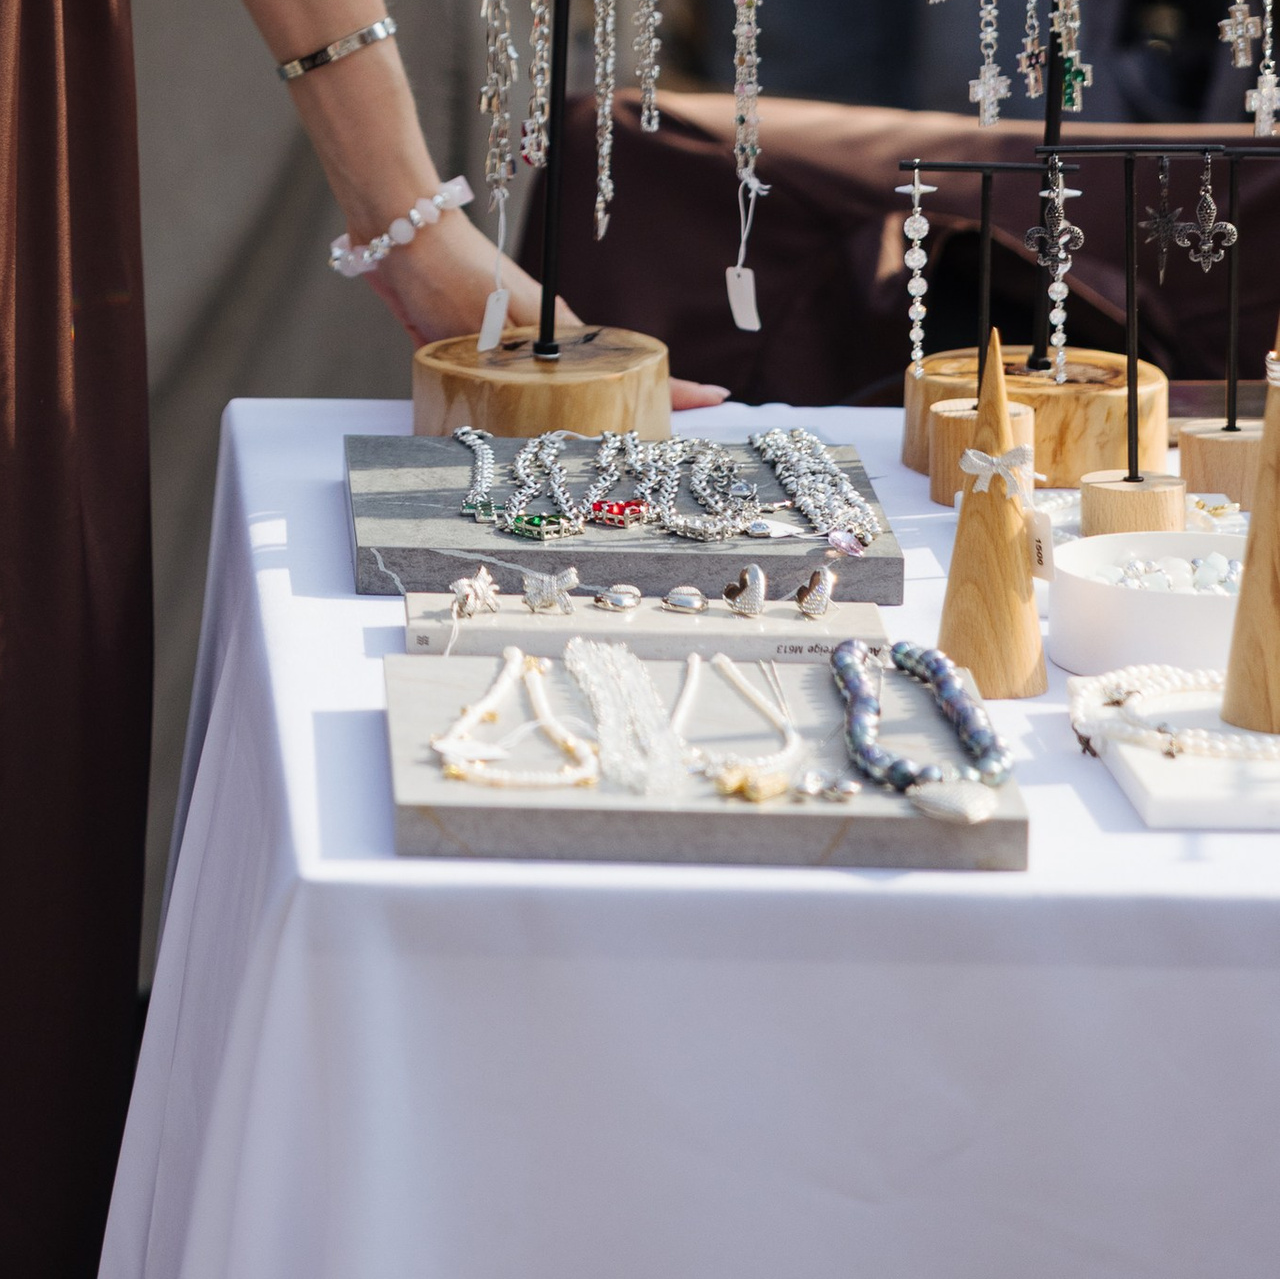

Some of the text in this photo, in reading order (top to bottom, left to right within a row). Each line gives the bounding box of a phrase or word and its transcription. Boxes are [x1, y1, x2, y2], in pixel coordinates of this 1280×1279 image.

[1035, 538, 1044, 566] 1500
[776, 644, 837, 656] reige M613
